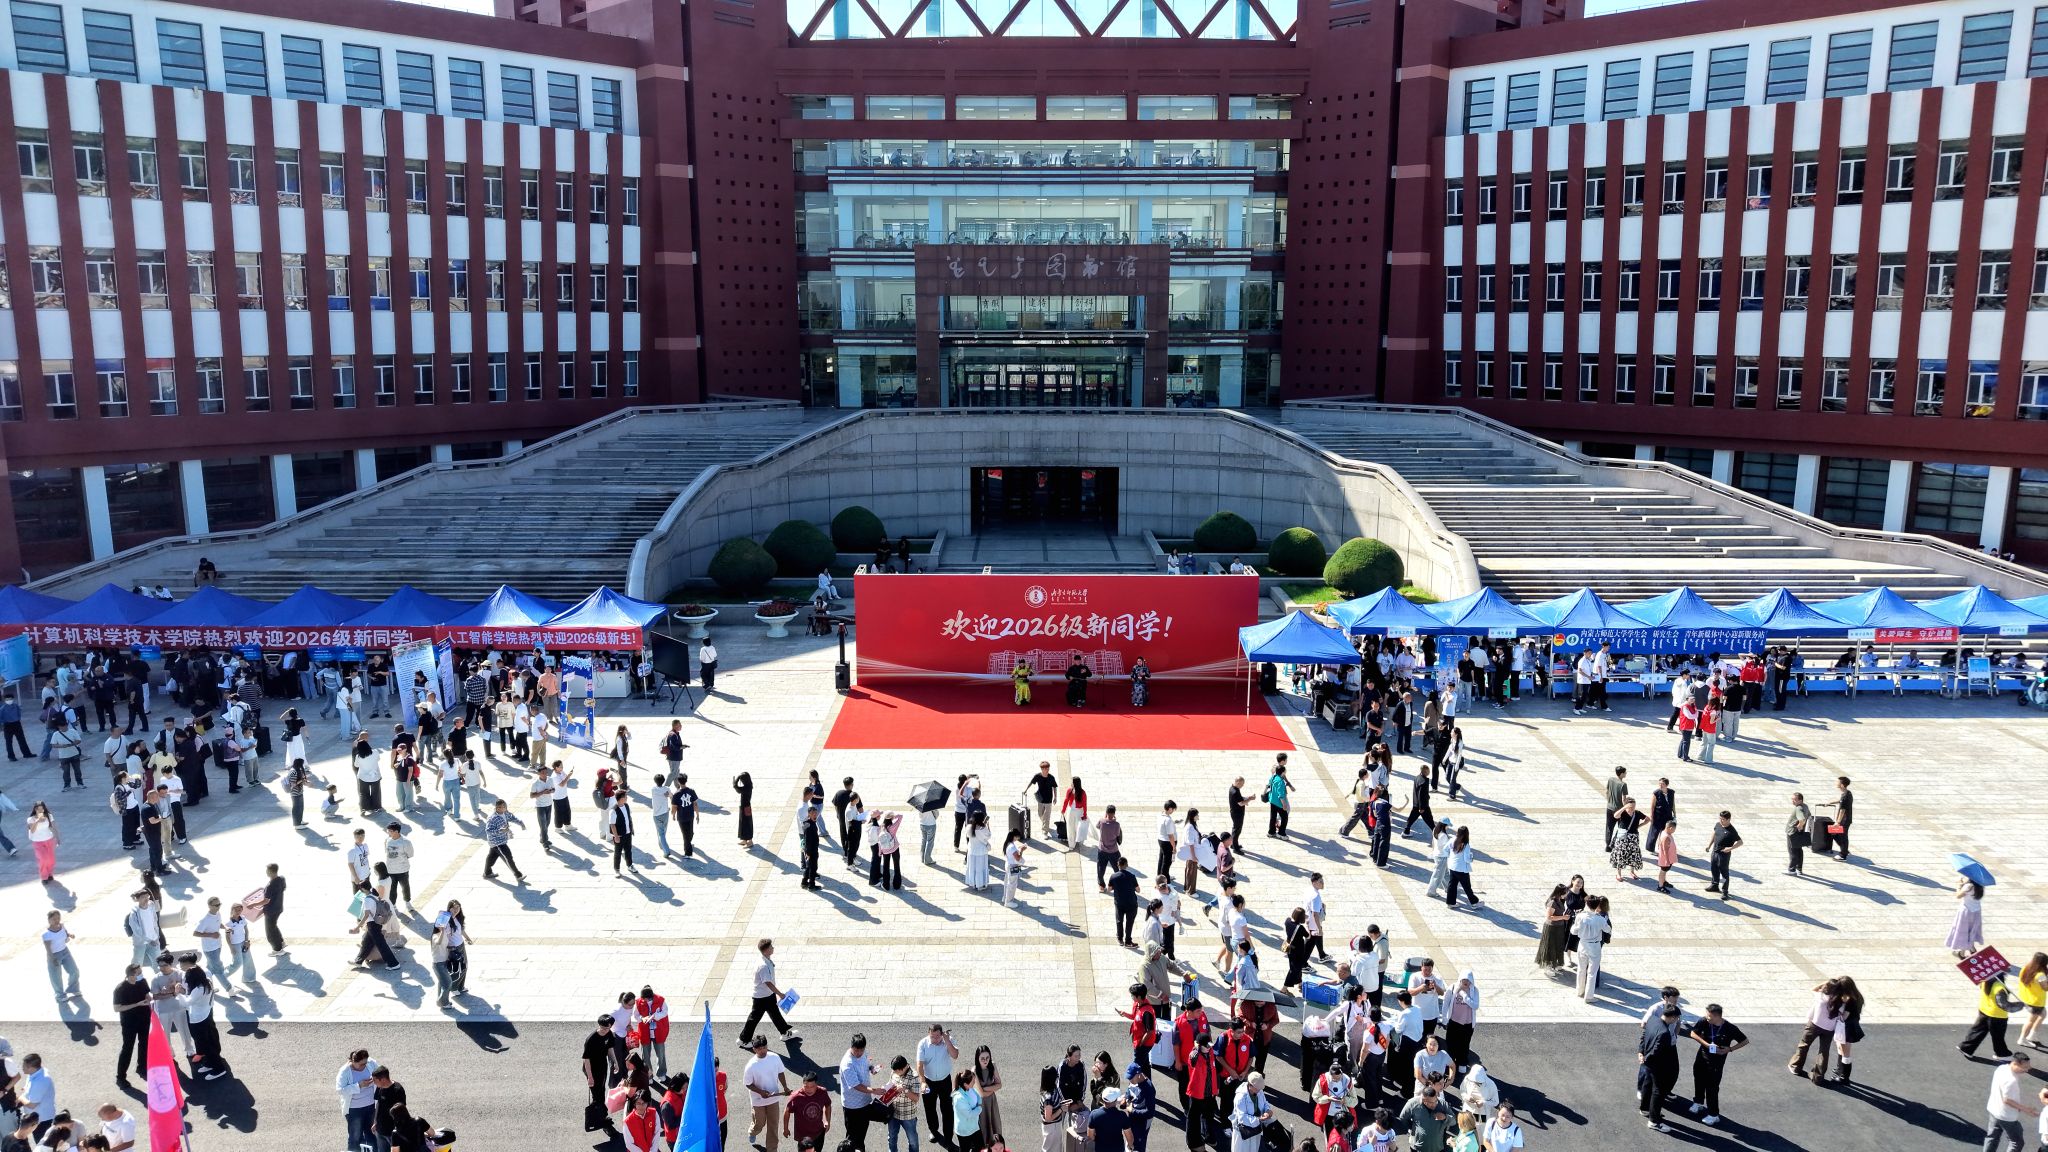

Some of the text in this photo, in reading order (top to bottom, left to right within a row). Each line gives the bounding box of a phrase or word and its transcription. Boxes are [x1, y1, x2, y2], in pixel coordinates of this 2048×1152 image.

[940, 609, 1173, 644] 欢迎2026级新同学!
[1652, 629, 1679, 639] 研究生会
[1878, 630, 1913, 638] 关爱师生
[1919, 629, 1953, 637] 守护健康
[447, 630, 636, 646] 人工智能学院热烈欢迎2026级新生!
[680, 793, 692, 808] NY
